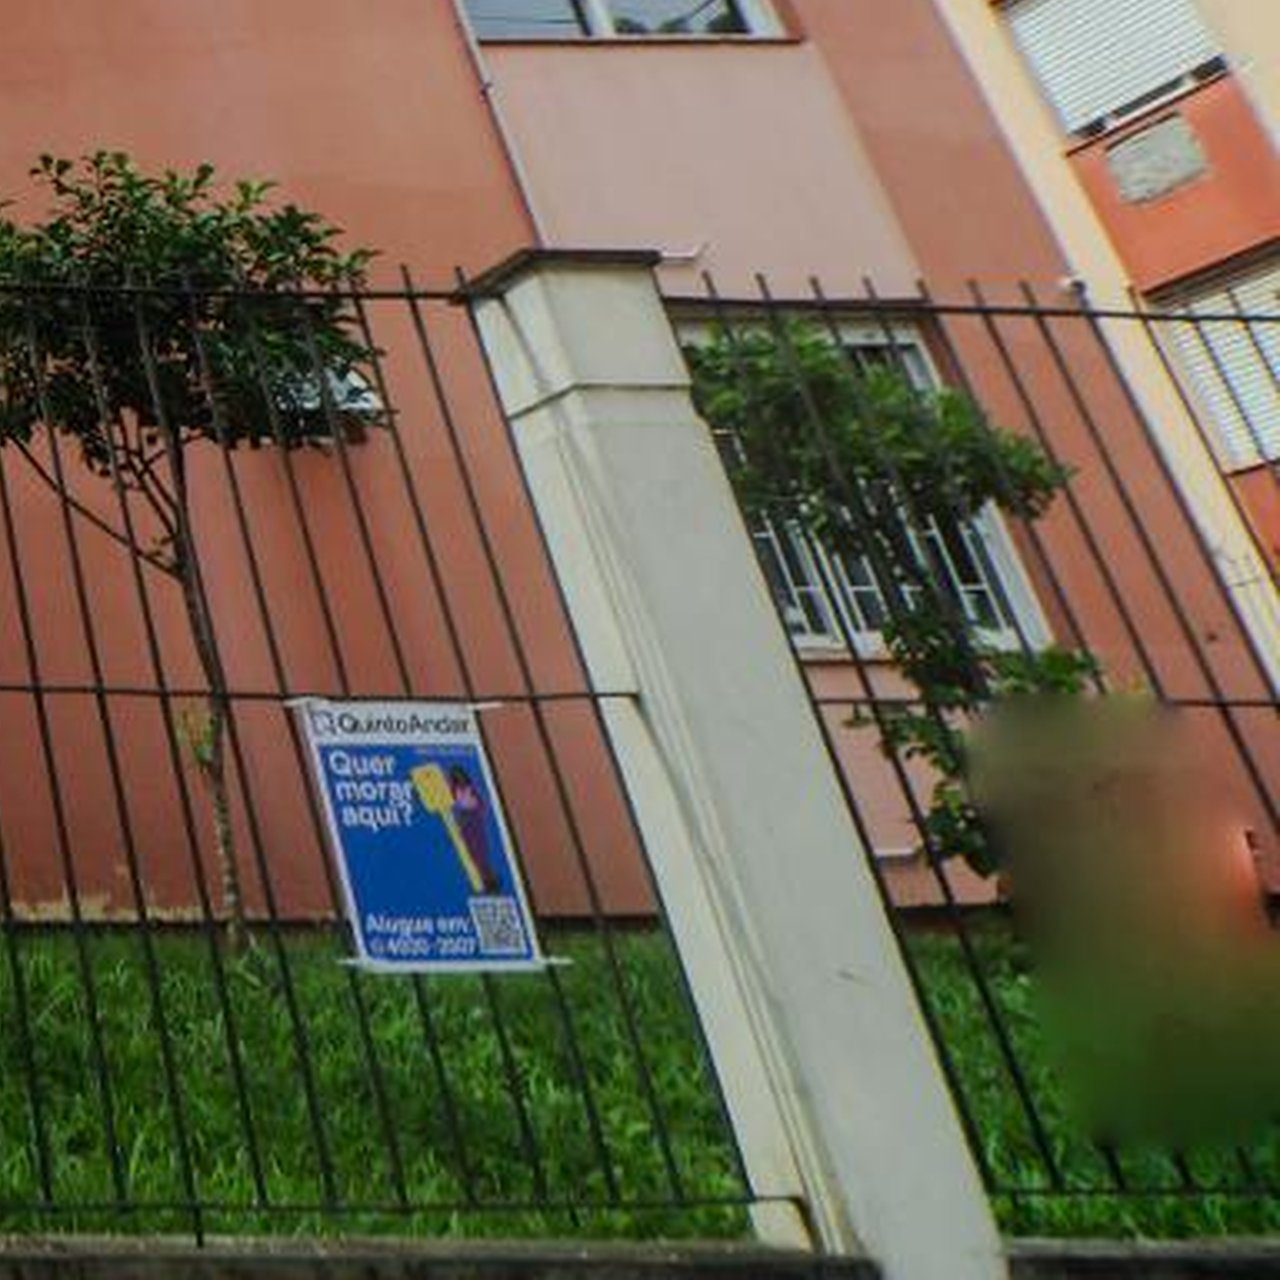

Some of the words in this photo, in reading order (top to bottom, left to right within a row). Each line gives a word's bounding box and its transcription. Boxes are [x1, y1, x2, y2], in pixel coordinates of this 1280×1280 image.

[328, 749, 396, 777] Quer
[335, 780, 415, 802] morar
[341, 800, 414, 833] aqui?
